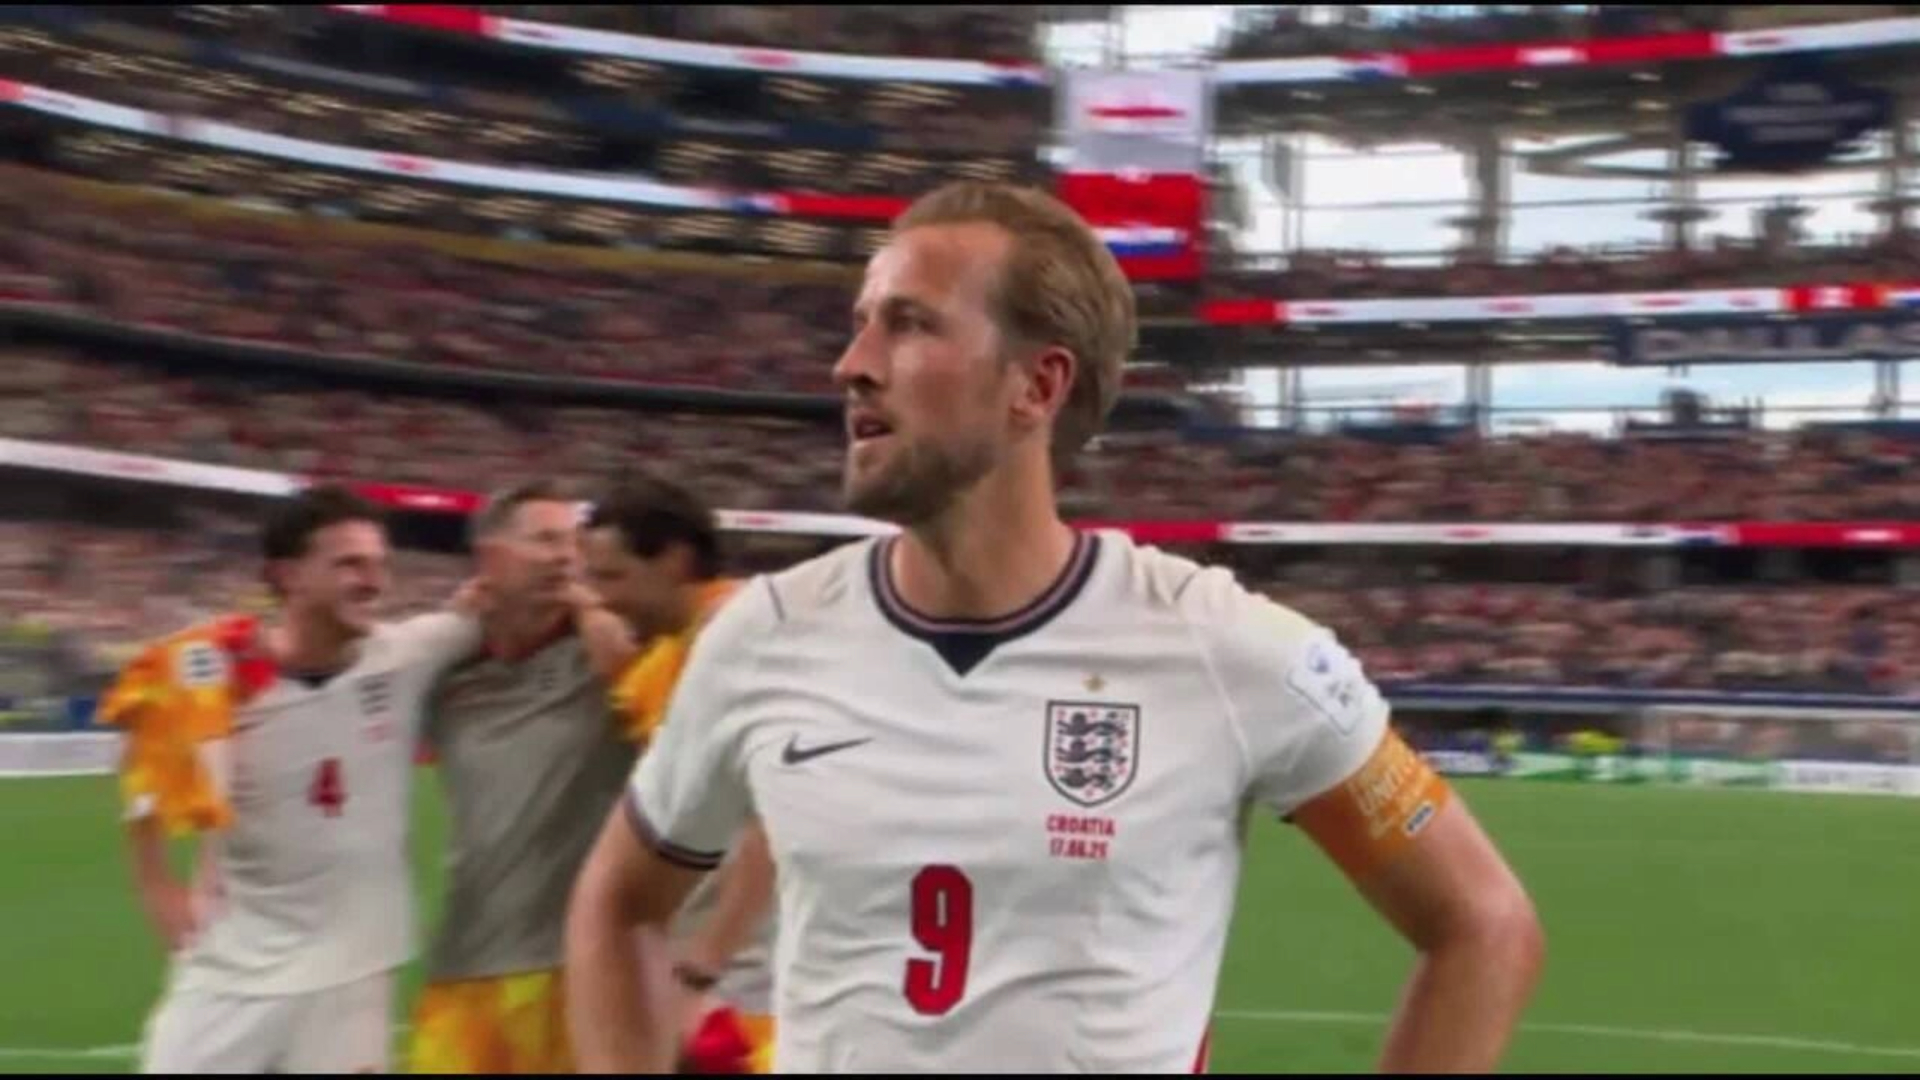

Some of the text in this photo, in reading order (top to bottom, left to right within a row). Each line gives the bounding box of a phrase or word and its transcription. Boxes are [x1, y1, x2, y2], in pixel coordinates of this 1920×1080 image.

[306, 758, 347, 818] 4
[1046, 814, 1115, 836] CROATIA
[903, 864, 973, 1015] 9
